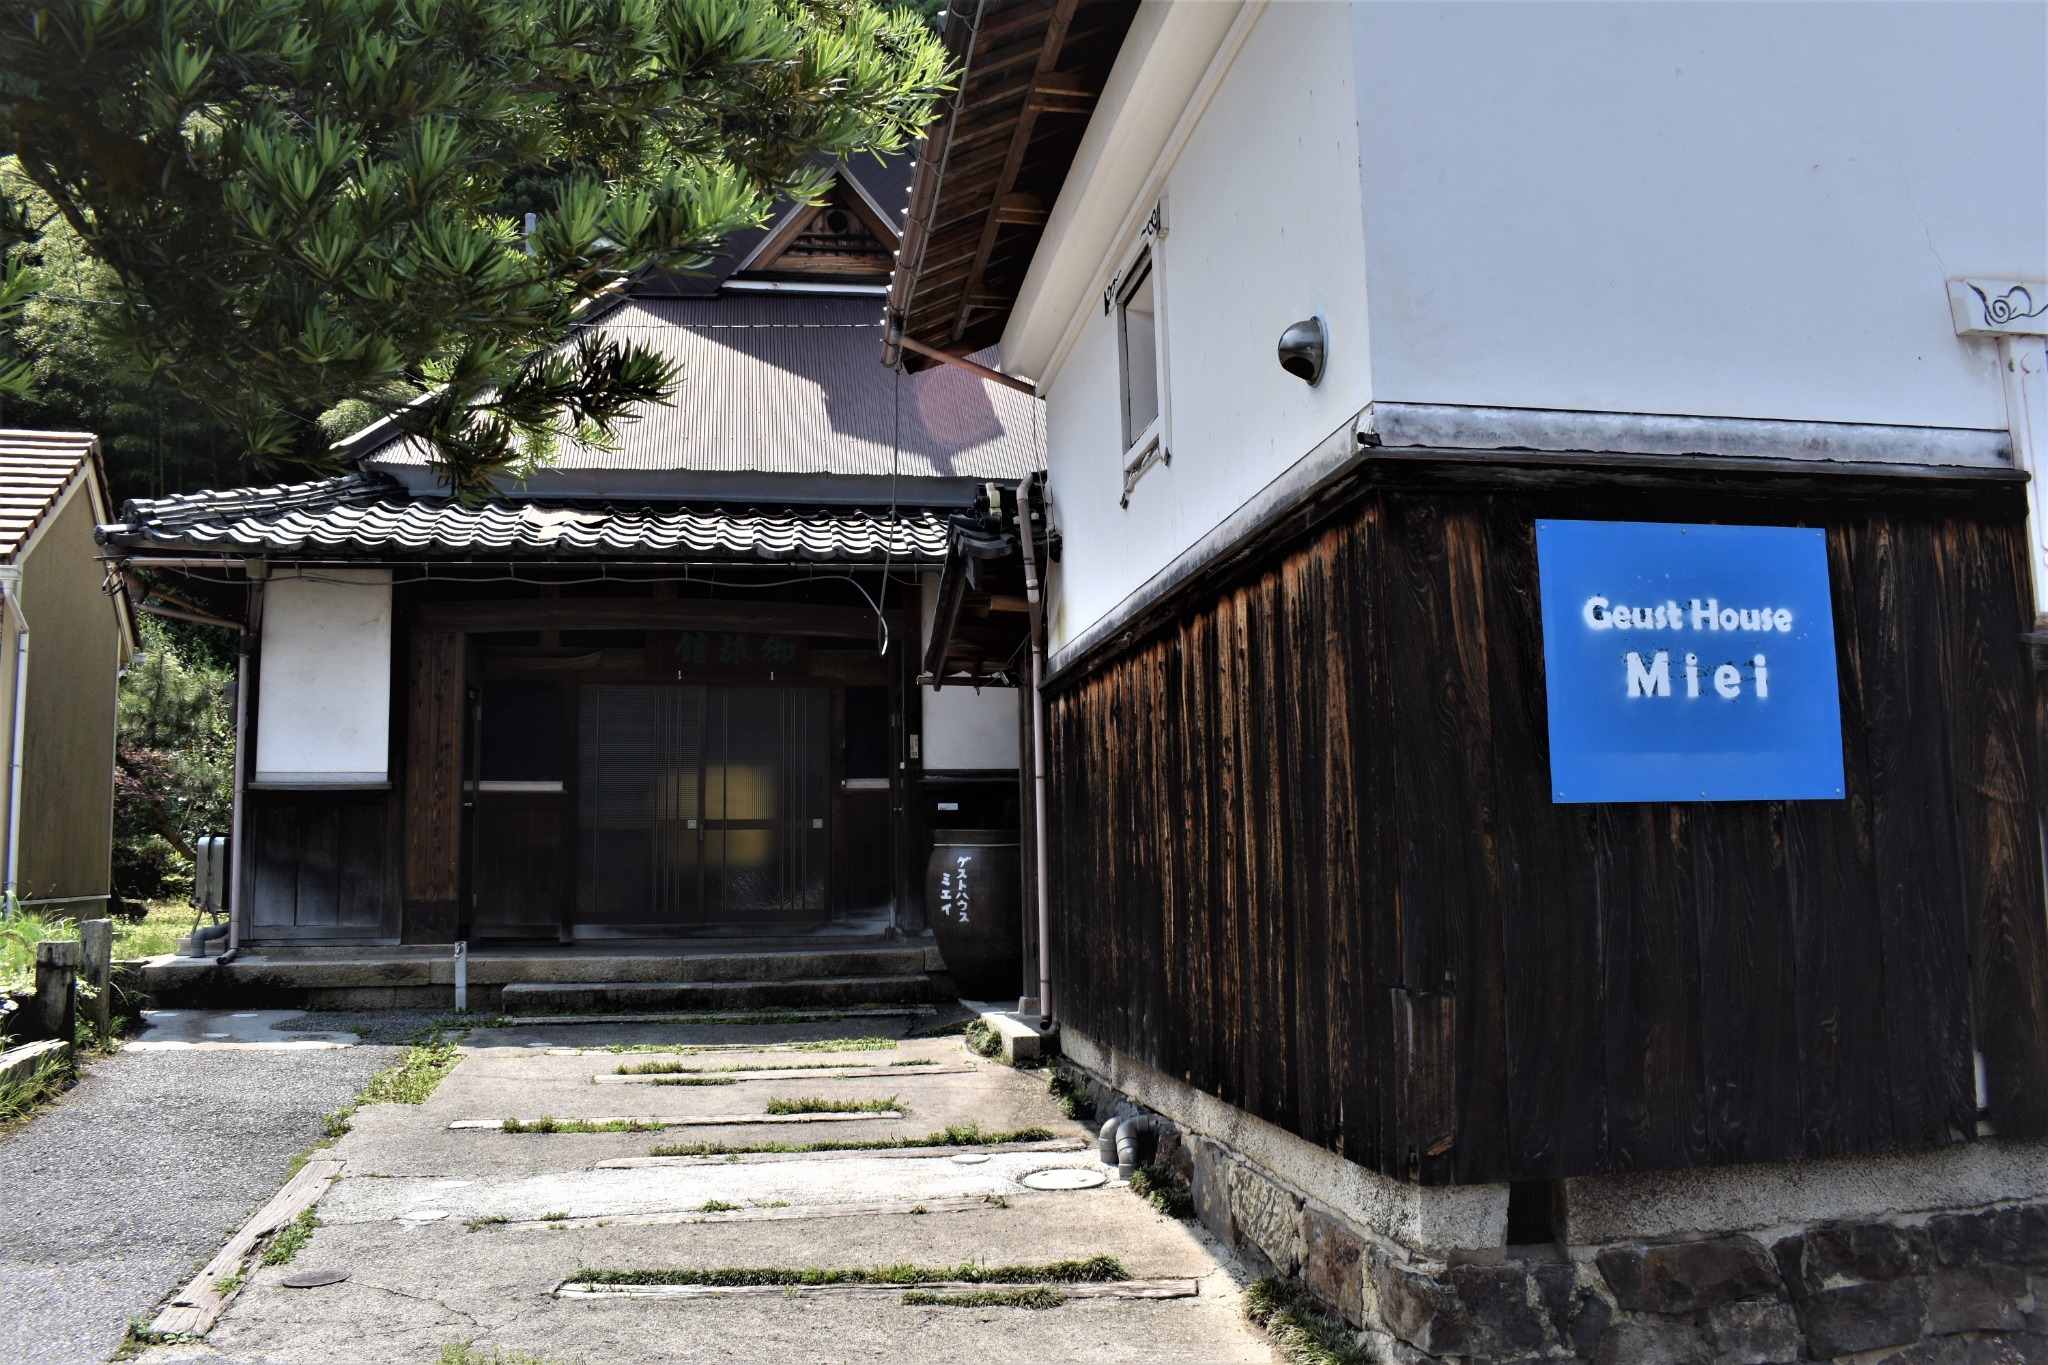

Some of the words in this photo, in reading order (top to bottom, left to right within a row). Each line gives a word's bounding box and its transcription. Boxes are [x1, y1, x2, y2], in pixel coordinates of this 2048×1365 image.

[1583, 596, 1683, 630] Geust
[1691, 599, 1793, 632] House
[1626, 652, 1769, 698] Miei
[940, 872, 953, 916] ミエイ
[956, 856, 972, 922] ゲストハウス
